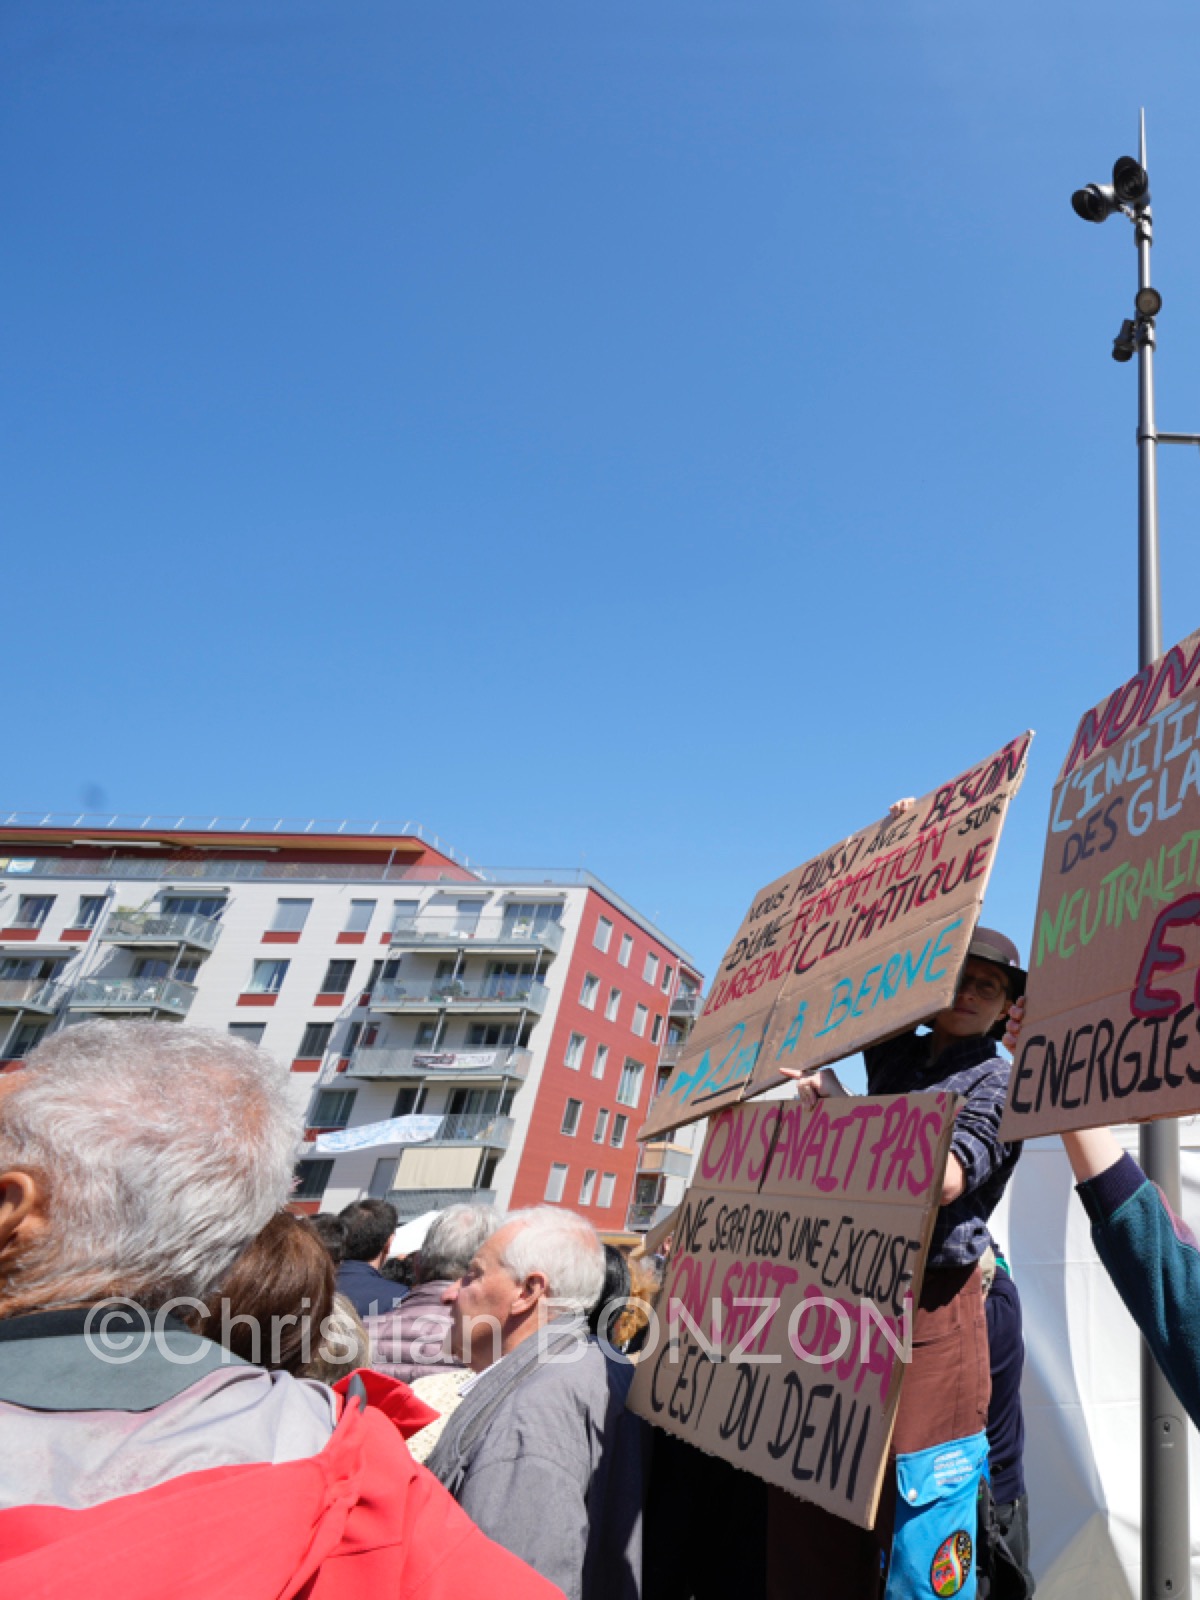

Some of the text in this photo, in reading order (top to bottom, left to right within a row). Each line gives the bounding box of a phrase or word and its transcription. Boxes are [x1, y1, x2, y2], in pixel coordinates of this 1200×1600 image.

[918, 736, 1030, 834] BESOIN
[1060, 796, 1124, 874] DES
[788, 817, 952, 941] FORMATION
[957, 793, 1008, 836] SUR
[794, 836, 994, 975] CLIMATIQUE
[814, 918, 964, 1038] BERNE
[748, 1100, 883, 1193] SAVAIT
[676, 1196, 921, 1317] NE SERA PLUS UNE EXCUSE
[651, 1333, 872, 1502] C'EST DU DENI
